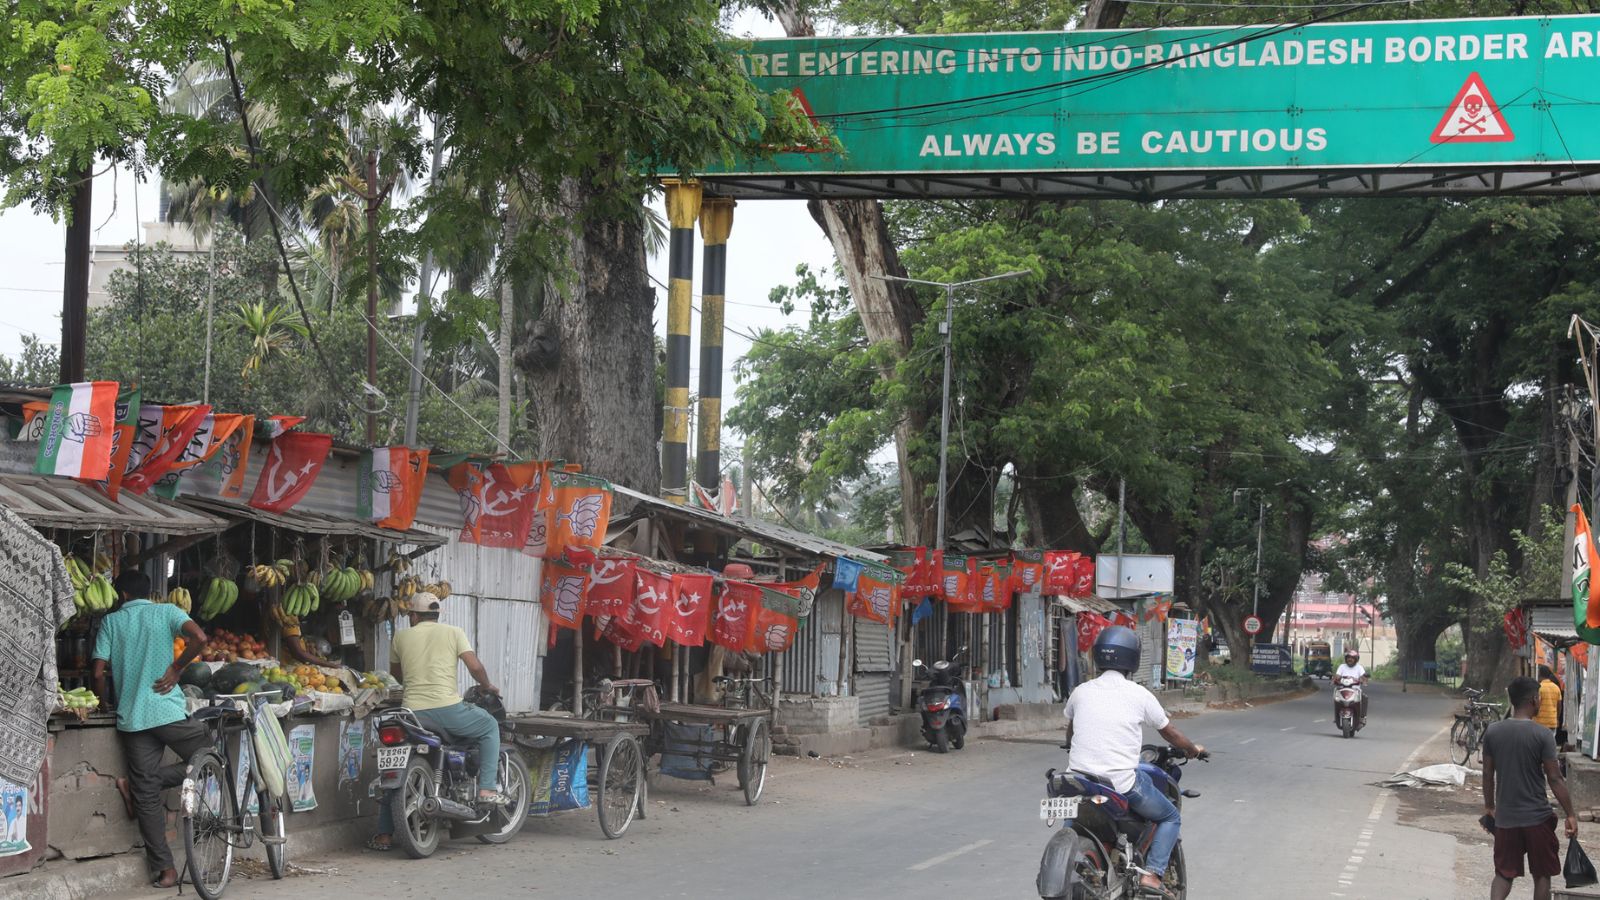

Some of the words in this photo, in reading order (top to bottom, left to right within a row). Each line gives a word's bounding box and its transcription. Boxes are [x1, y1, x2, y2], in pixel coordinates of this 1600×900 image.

[799, 50, 955, 76] ENTERING
[967, 48, 1041, 73] INTO
[1053, 38, 1372, 71] INDO-BANGLADESH
[1385, 33, 1528, 63] BORDER
[1544, 31, 1600, 58] AR
[919, 133, 1055, 157] ALWAYS
[1077, 132, 1120, 155] BE
[1141, 128, 1327, 154] CAUTIOUS
[44, 401, 64, 457] CONGRESS
[379, 756, 405, 768] 5922
